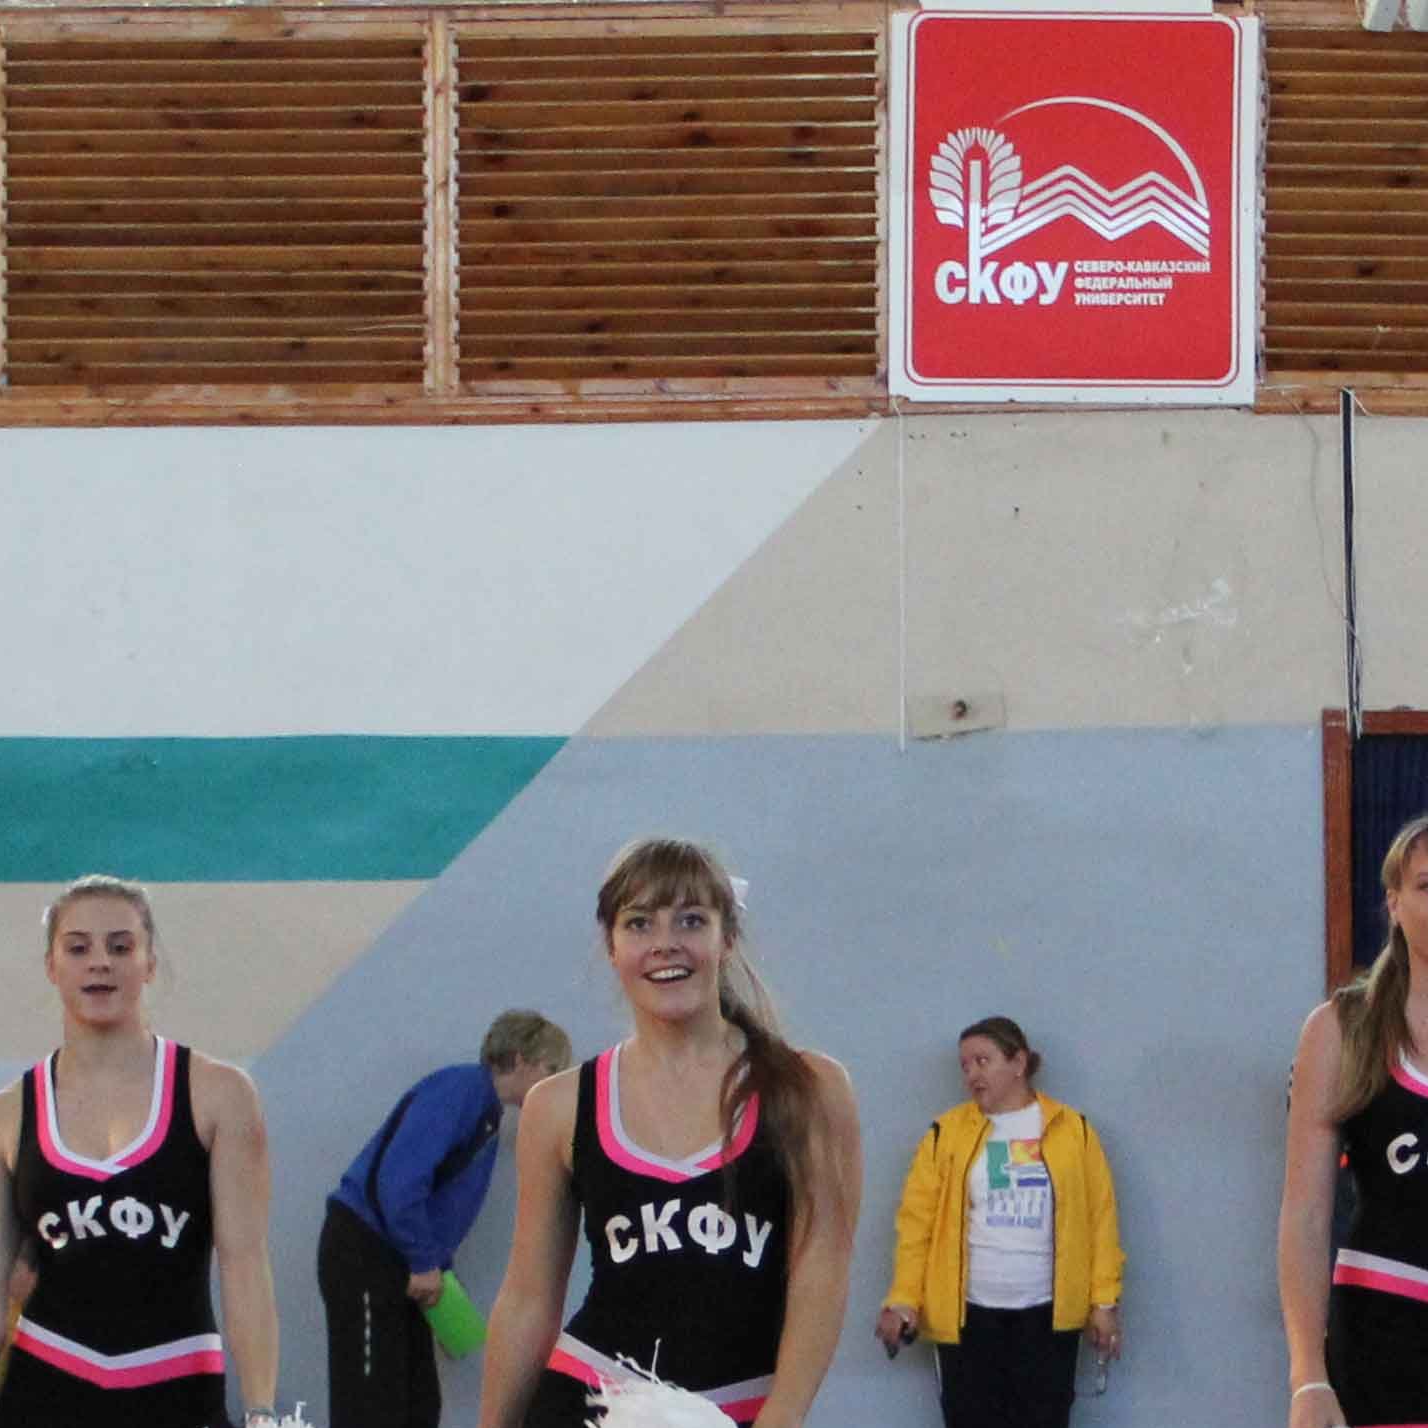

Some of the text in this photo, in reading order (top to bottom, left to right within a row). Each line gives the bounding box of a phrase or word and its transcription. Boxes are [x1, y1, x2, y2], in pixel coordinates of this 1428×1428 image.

[1074, 259, 1211, 273] СЕВЕРО-КАВКАЗСКИЙ
[934, 260, 1069, 305] СКФУ
[1074, 276, 1173, 290] ФЕДЕРАЛЬНЫЙ
[1074, 293, 1166, 306] УНИВЕРСИТЕТ
[37, 1194, 190, 1249] СКФУ
[605, 1198, 773, 1268] СКФУ
